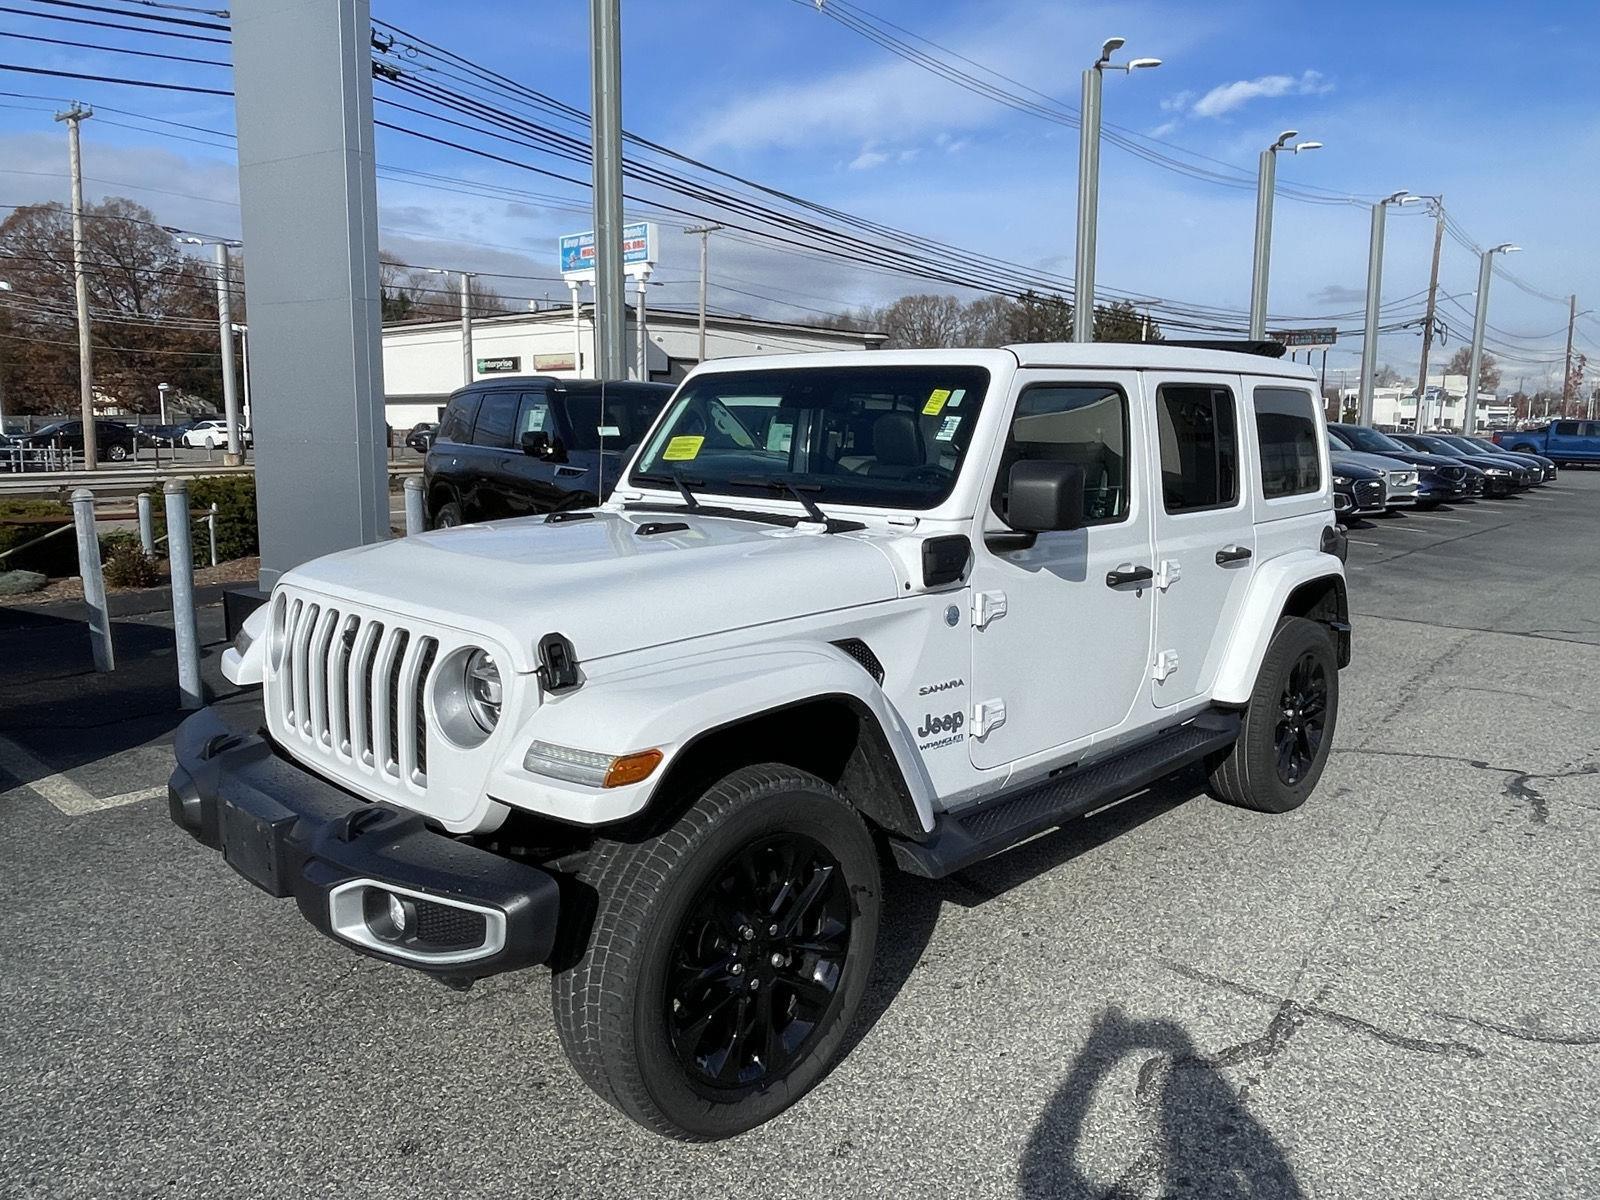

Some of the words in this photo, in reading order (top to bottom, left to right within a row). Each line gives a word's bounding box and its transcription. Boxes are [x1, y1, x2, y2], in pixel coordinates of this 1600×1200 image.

[478, 359, 514, 370] enterprise
[918, 679, 964, 696] SAHARA
[917, 711, 964, 738] Jeep
[919, 733, 964, 750] WRANGLER
